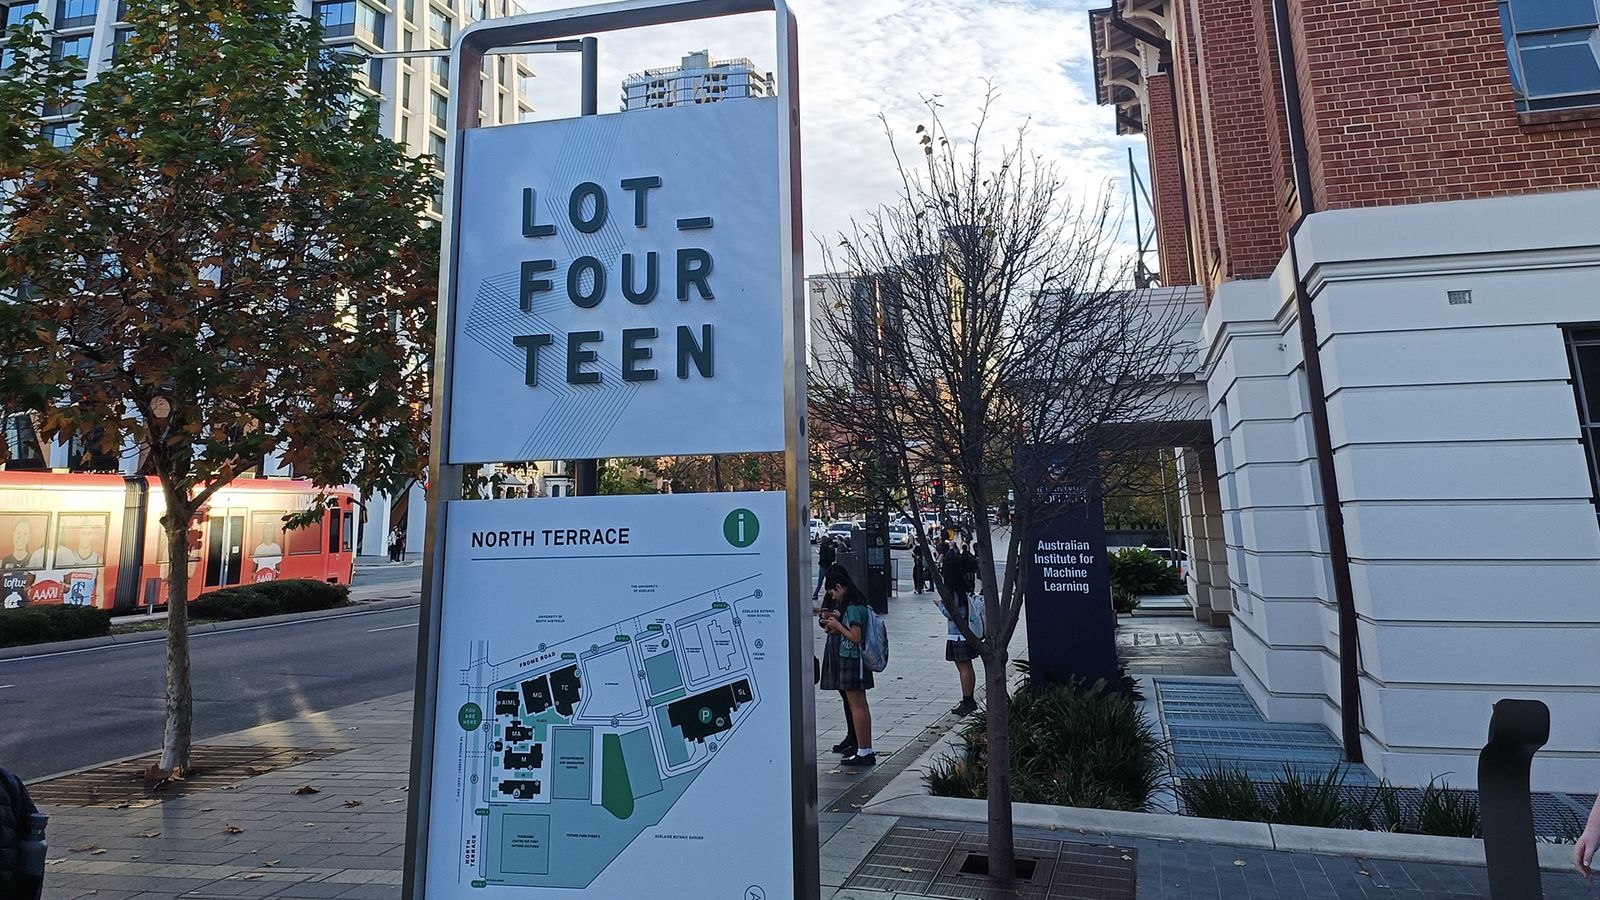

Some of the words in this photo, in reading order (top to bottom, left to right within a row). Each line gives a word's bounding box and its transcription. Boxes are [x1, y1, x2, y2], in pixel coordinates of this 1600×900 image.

[519, 248, 714, 312] FOUR
[512, 324, 714, 386] TEEN
[472, 530, 534, 548] NORTH
[542, 528, 630, 546] TERRACE
[1038, 540, 1090, 550] Australian
[1034, 554, 1076, 564] Institute
[1079, 554, 1094, 564] for
[1044, 567, 1088, 578] Machine
[32, 586, 58, 600] AAMI
[1044, 581, 1090, 594] Learning
[540, 652, 556, 660] ROAD
